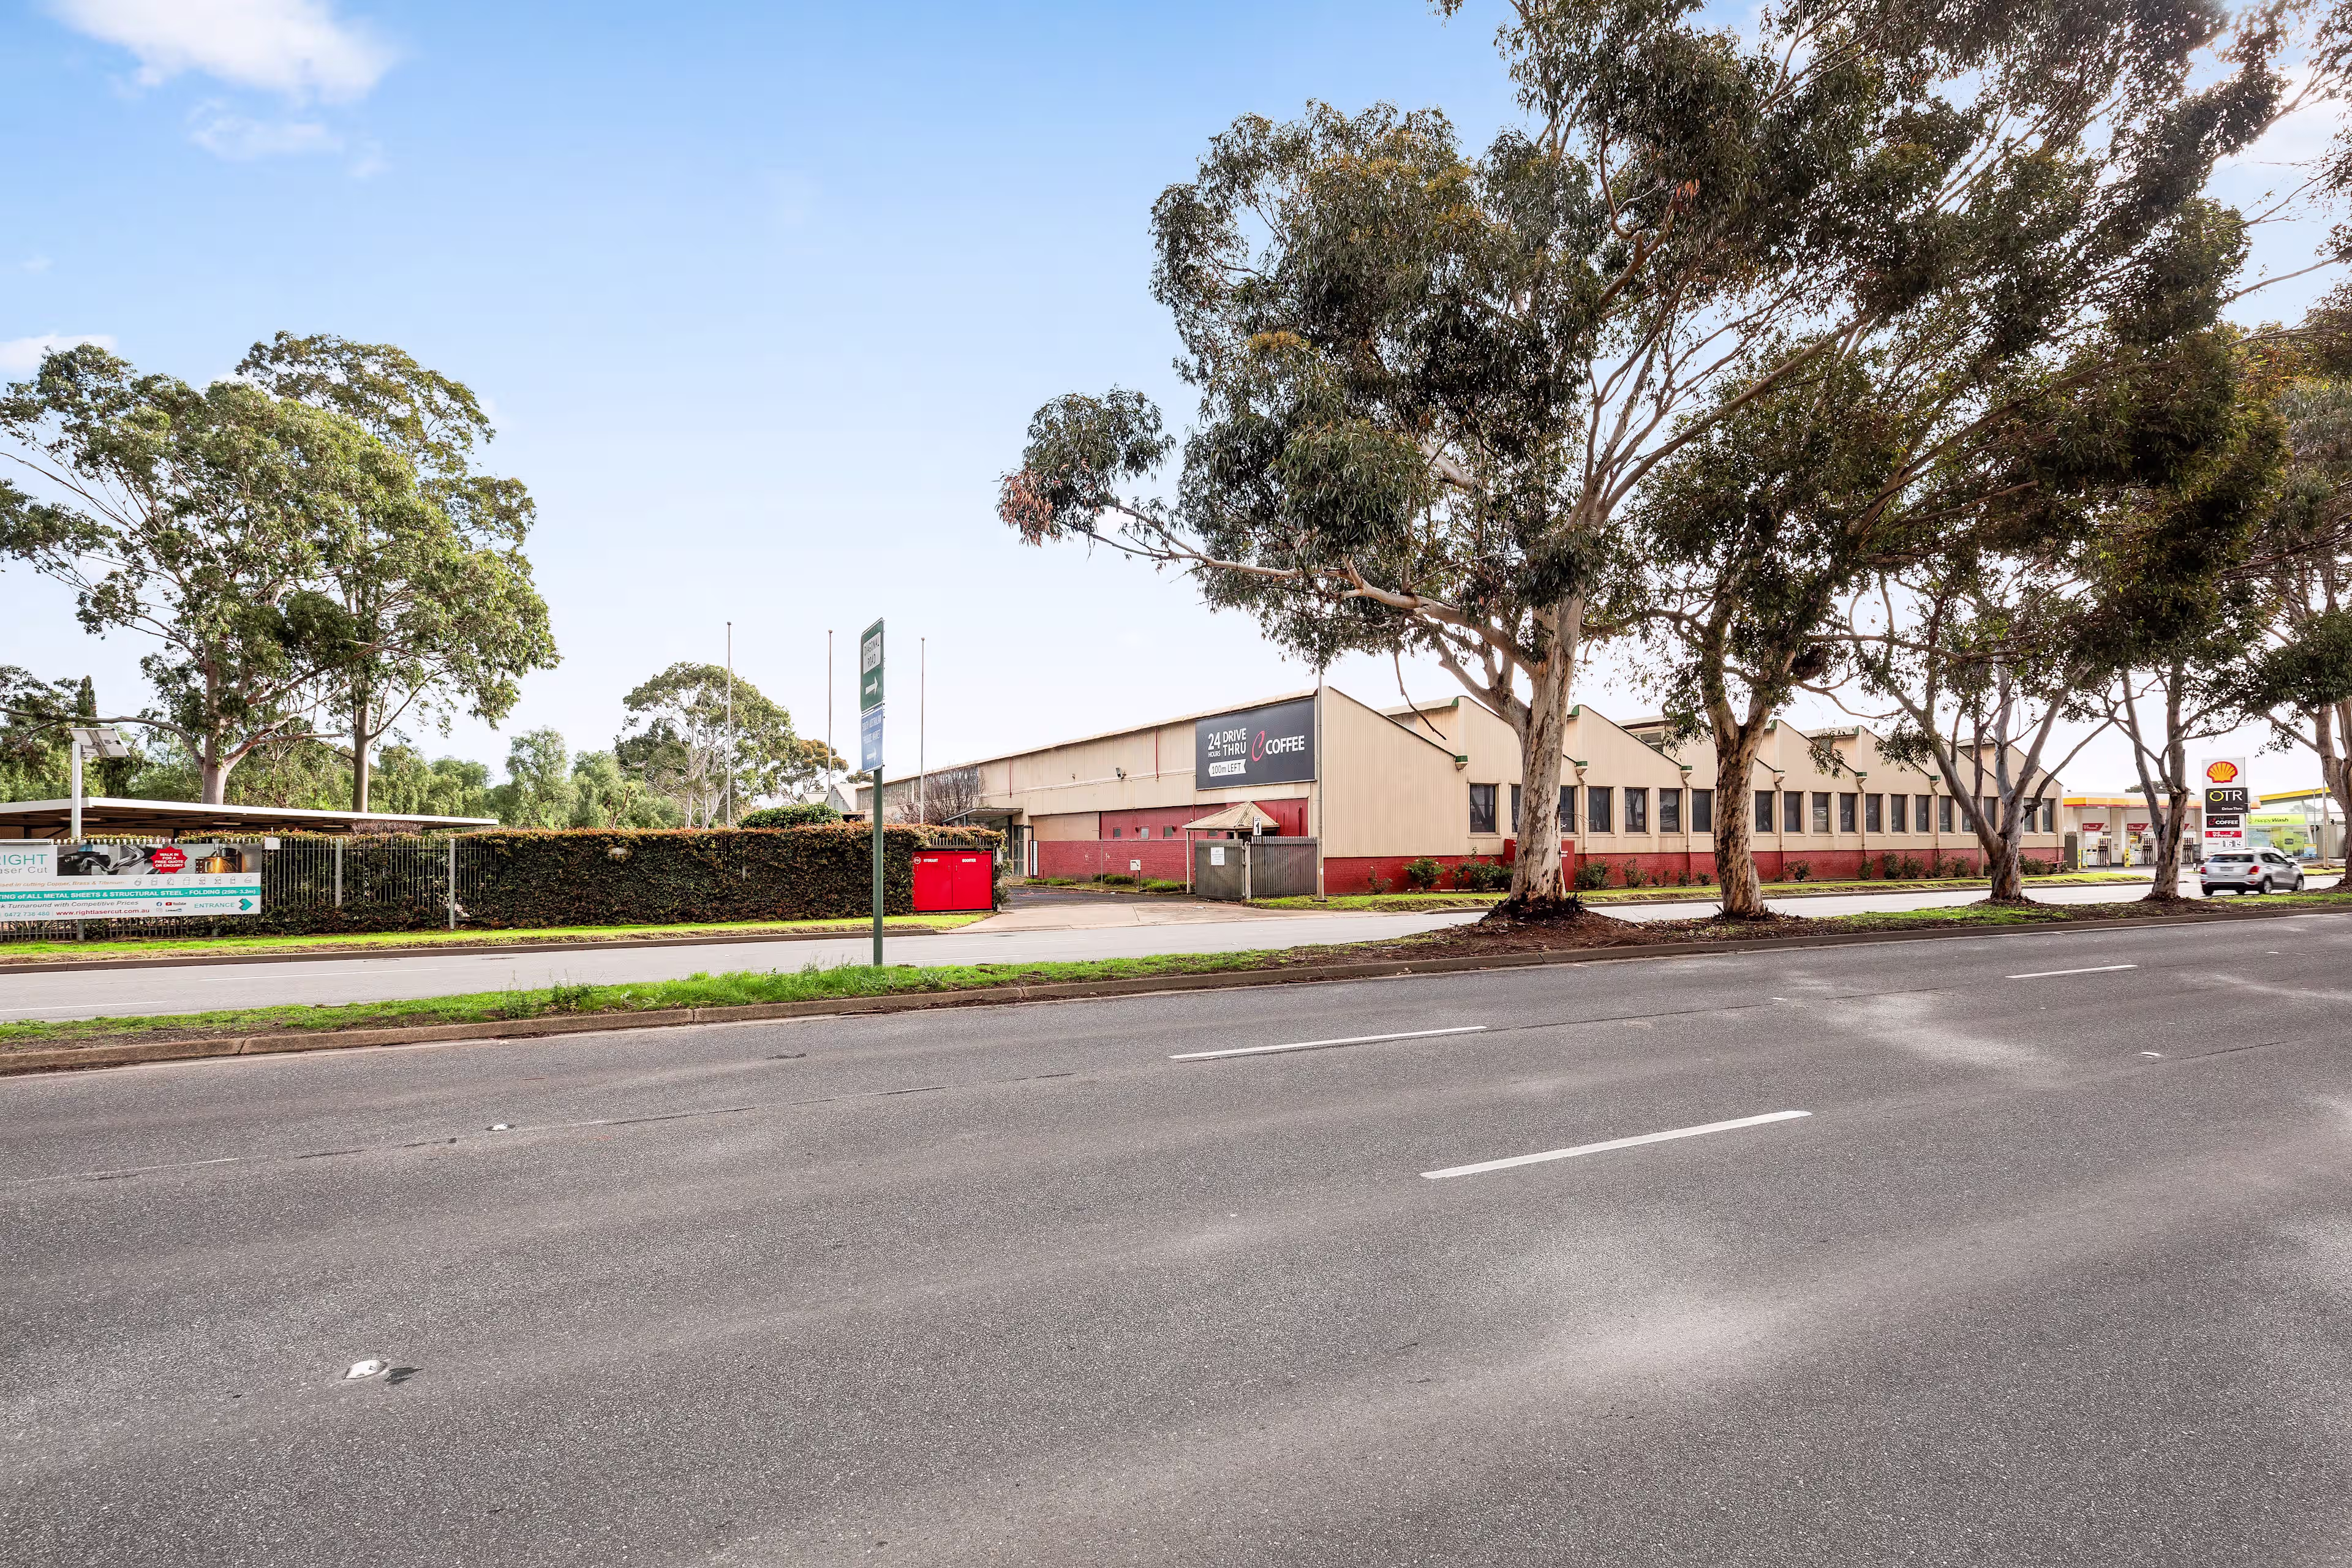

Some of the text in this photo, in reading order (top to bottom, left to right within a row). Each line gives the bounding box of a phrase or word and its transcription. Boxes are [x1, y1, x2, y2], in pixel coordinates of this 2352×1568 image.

[867, 654, 876, 668] ROAD
[1208, 731, 1221, 750] 24
[1223, 728, 1246, 743] DRIVE
[1223, 742, 1246, 756] THRU
[1265, 735, 1305, 755] COFFEE
[1212, 763, 1241, 774] 100m LEFT
[2209, 790, 2243, 802] OTR
[1256, 822, 1259, 834] 1
[0, 854, 48, 865] IGHT
